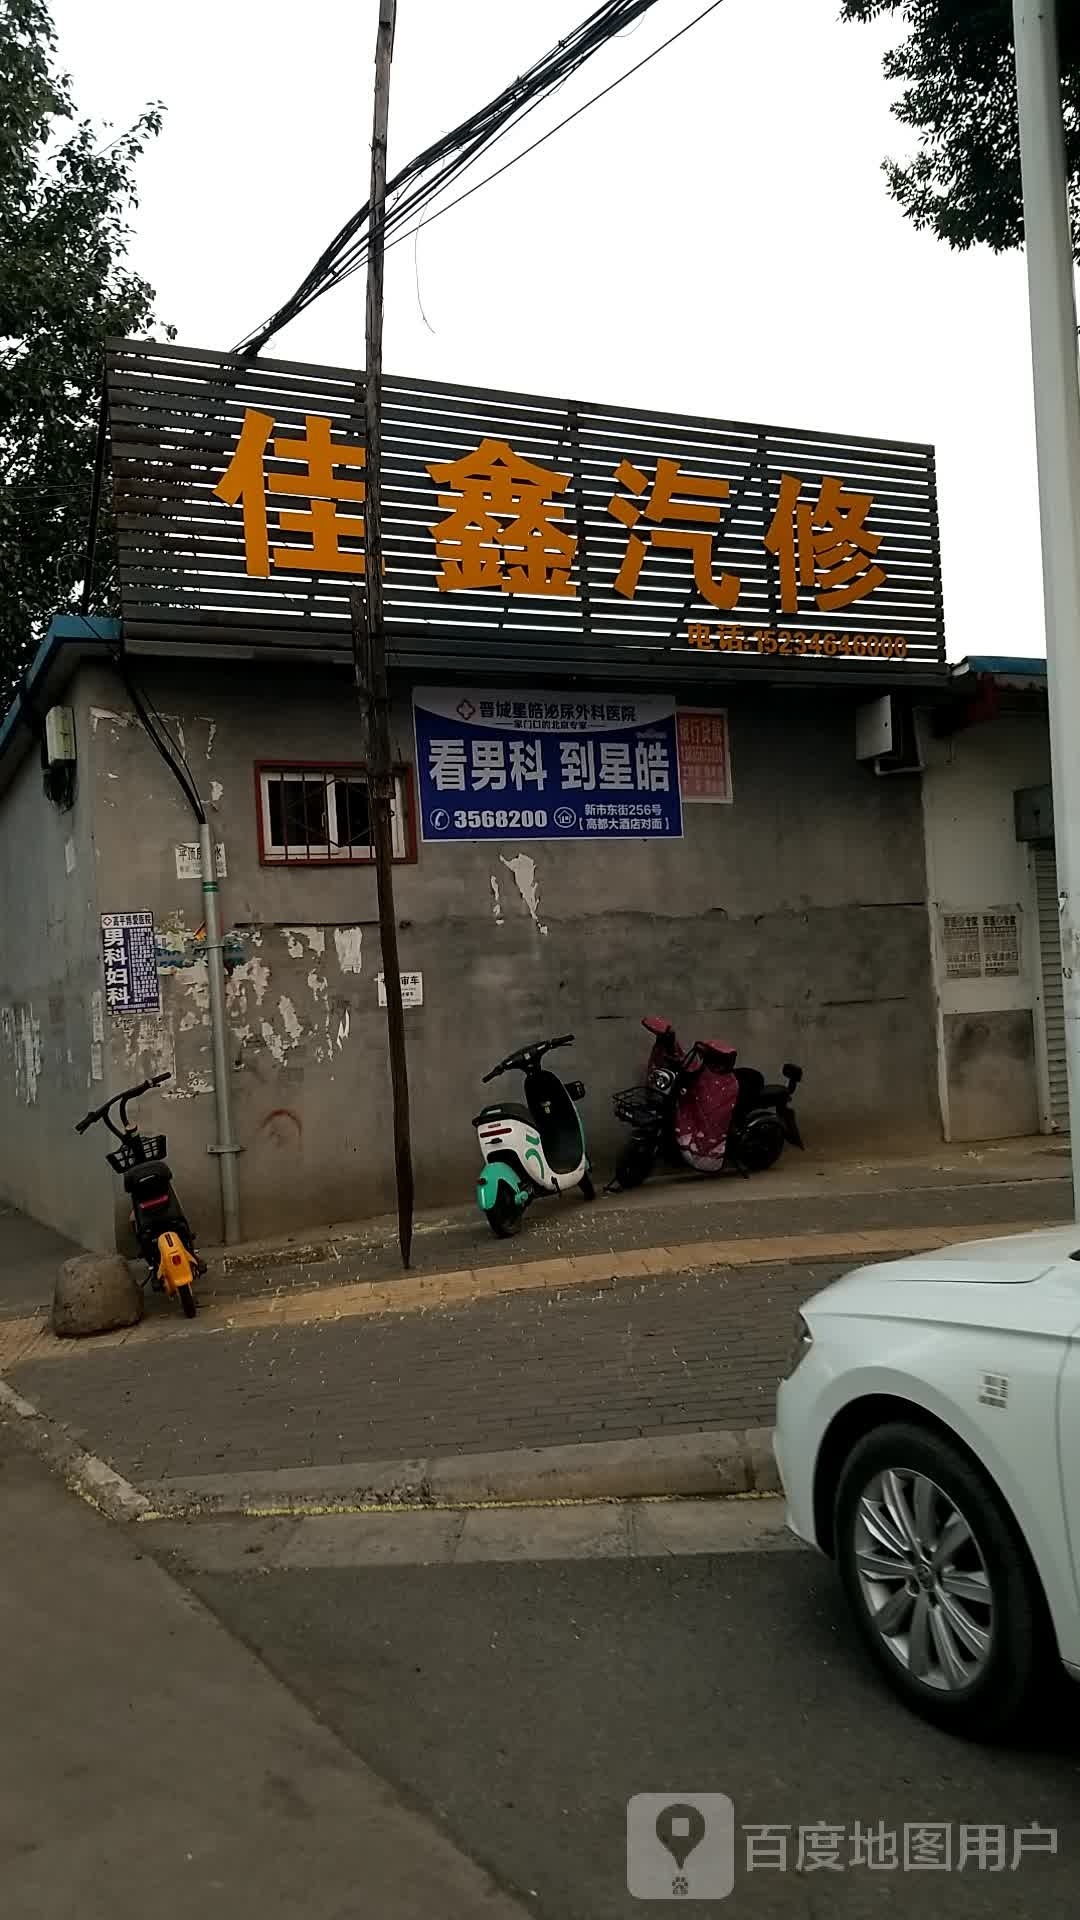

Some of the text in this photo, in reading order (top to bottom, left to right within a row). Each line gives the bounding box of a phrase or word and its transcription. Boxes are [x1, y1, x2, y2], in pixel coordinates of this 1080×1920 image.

[211, 407, 888, 614] 佳鑫汽修
[479, 700, 636, 721] 晋城星皓泌尿外科医院
[428, 739, 548, 791] 看男科
[559, 741, 670, 792] 到星皓
[454, 810, 548, 828] 3568200
[584, 804, 662, 816] 新市东街256号
[104, 928, 130, 1005] 男科妇科
